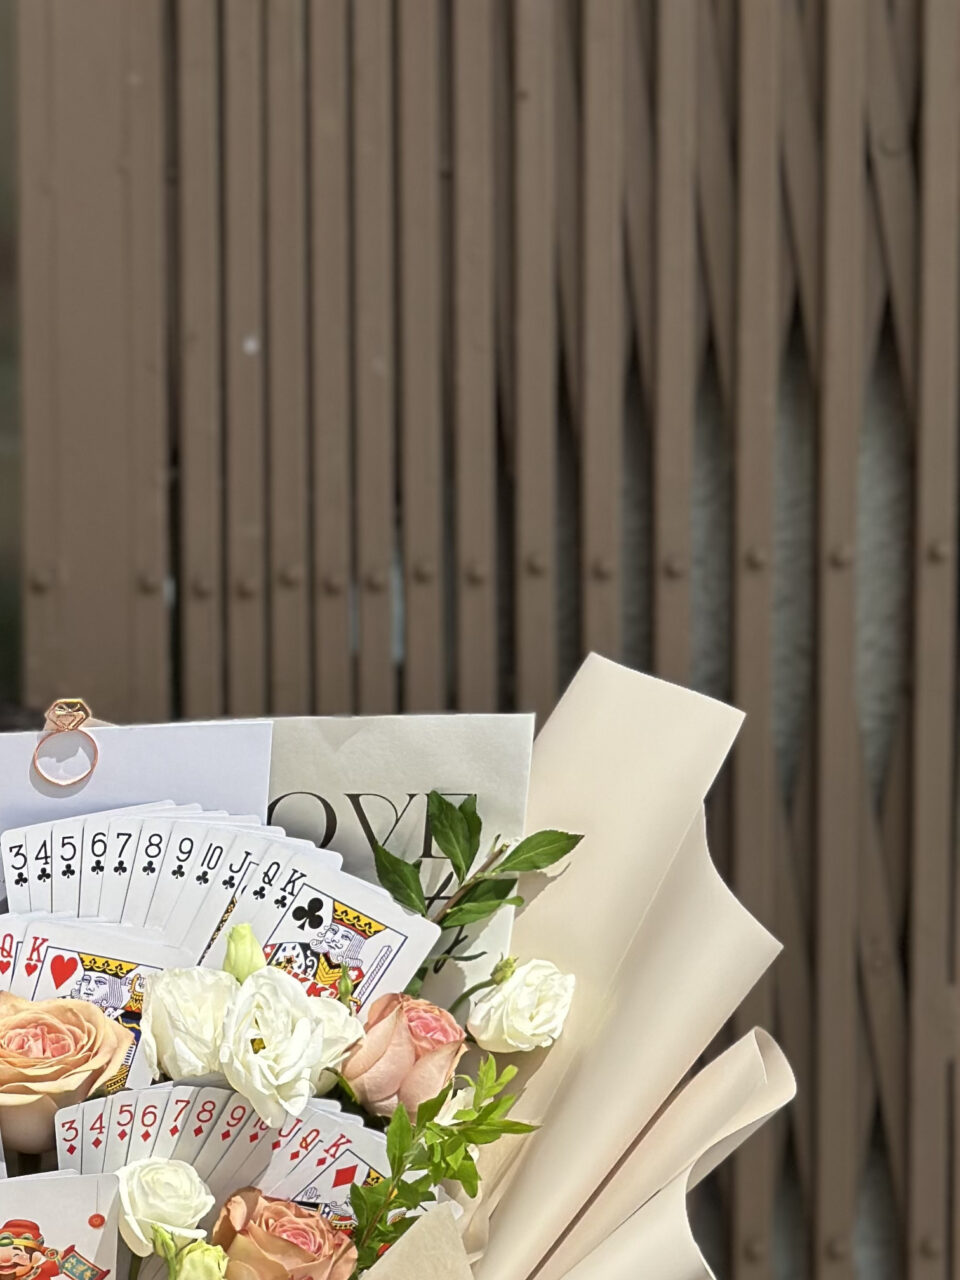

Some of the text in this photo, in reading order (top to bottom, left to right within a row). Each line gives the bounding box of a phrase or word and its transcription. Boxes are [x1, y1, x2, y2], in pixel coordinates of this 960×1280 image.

[9, 832, 307, 897] 3 4 5 6 7 8 9 10 J Q K
[0, 933, 13, 959] Q
[26, 936, 49, 963] K
[61, 1119, 79, 1143] 3
[89, 1112, 105, 1135] 4
[117, 1104, 133, 1127] 5
[141, 1104, 157, 1128] 6
[173, 1099, 190, 1123] 7
[196, 1100, 216, 1123] 8
[226, 1105, 246, 1128] 9
[323, 1133, 352, 1159] K
